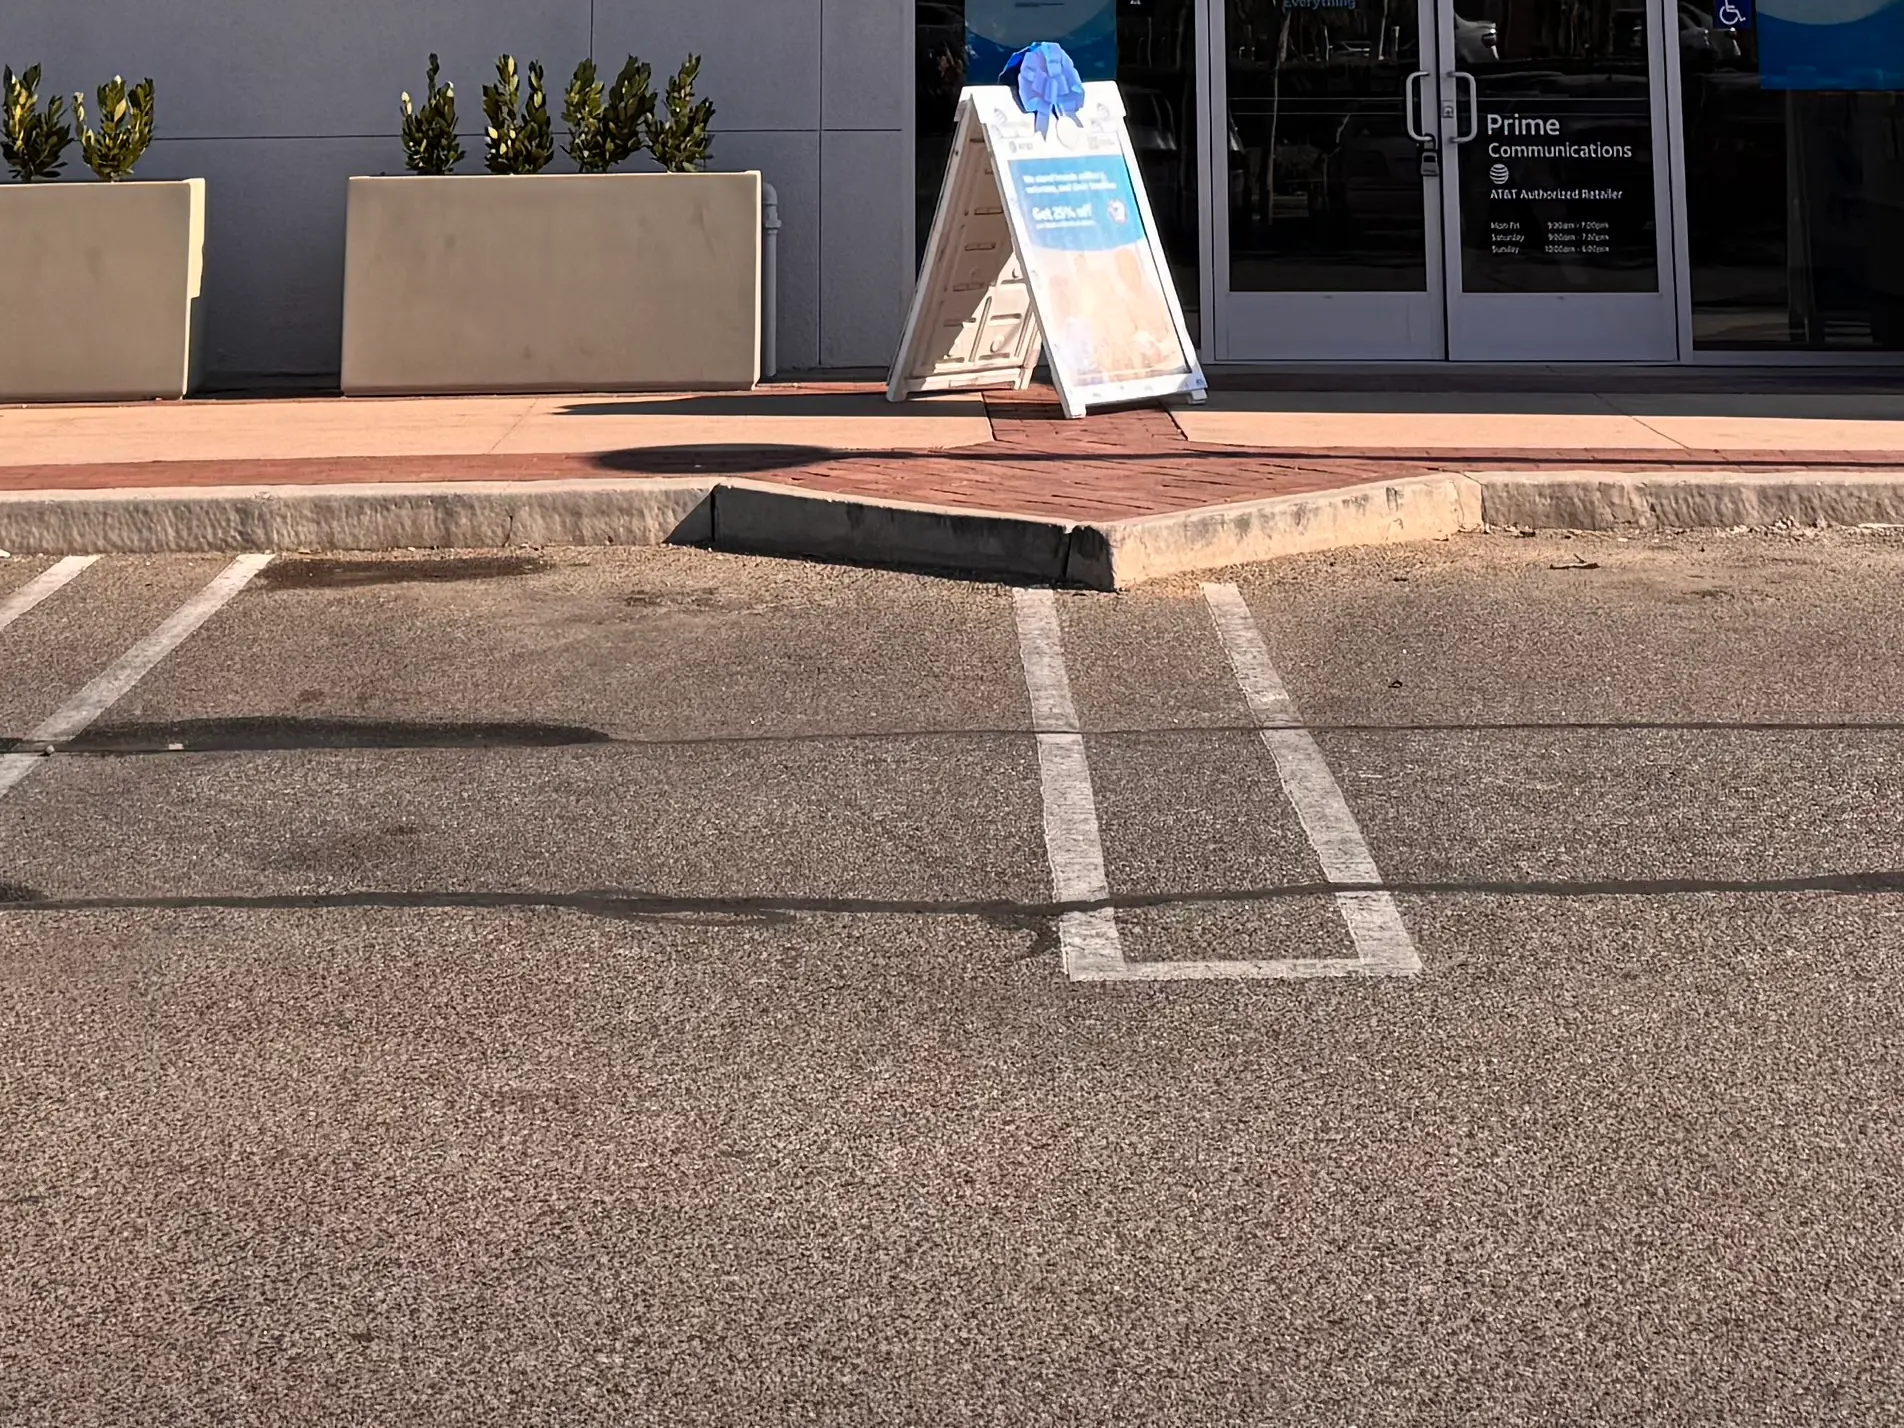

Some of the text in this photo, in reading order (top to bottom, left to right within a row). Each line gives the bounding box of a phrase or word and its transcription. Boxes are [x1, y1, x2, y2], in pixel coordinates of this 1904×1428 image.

[1487, 113, 1560, 136] Prime
[1488, 142, 1633, 158] Communications
[1490, 188, 1623, 200] AT&T Authorized Retailer
